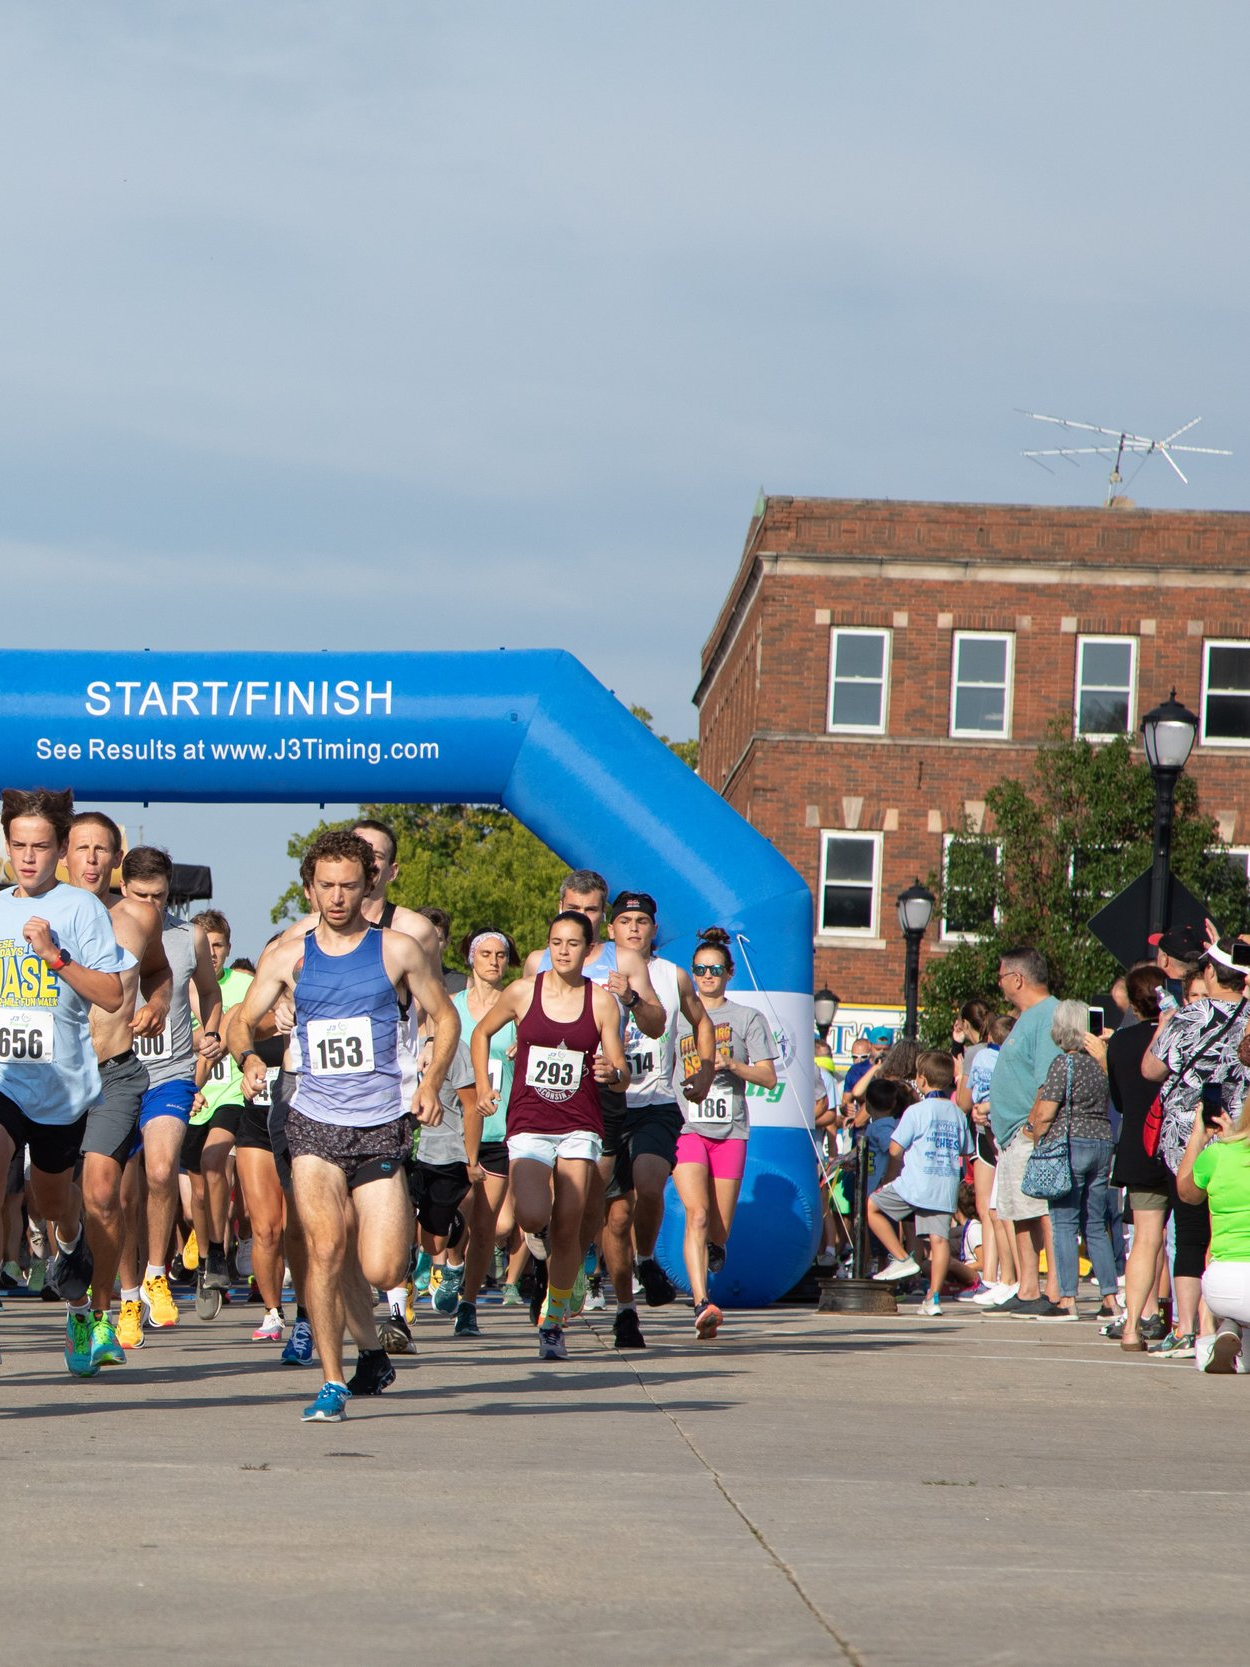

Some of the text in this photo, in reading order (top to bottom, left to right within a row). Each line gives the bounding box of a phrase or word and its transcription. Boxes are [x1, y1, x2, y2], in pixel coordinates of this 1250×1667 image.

[85, 680, 393, 717] START/FINISH
[36, 737, 440, 764] See Results at www.J3Timing.com
[20, 997, 36, 1007] FUN
[37, 998, 59, 1007] WALK
[316, 1036, 364, 1069] 153
[534, 1060, 574, 1086] 293
[697, 1098, 727, 1118] 186
